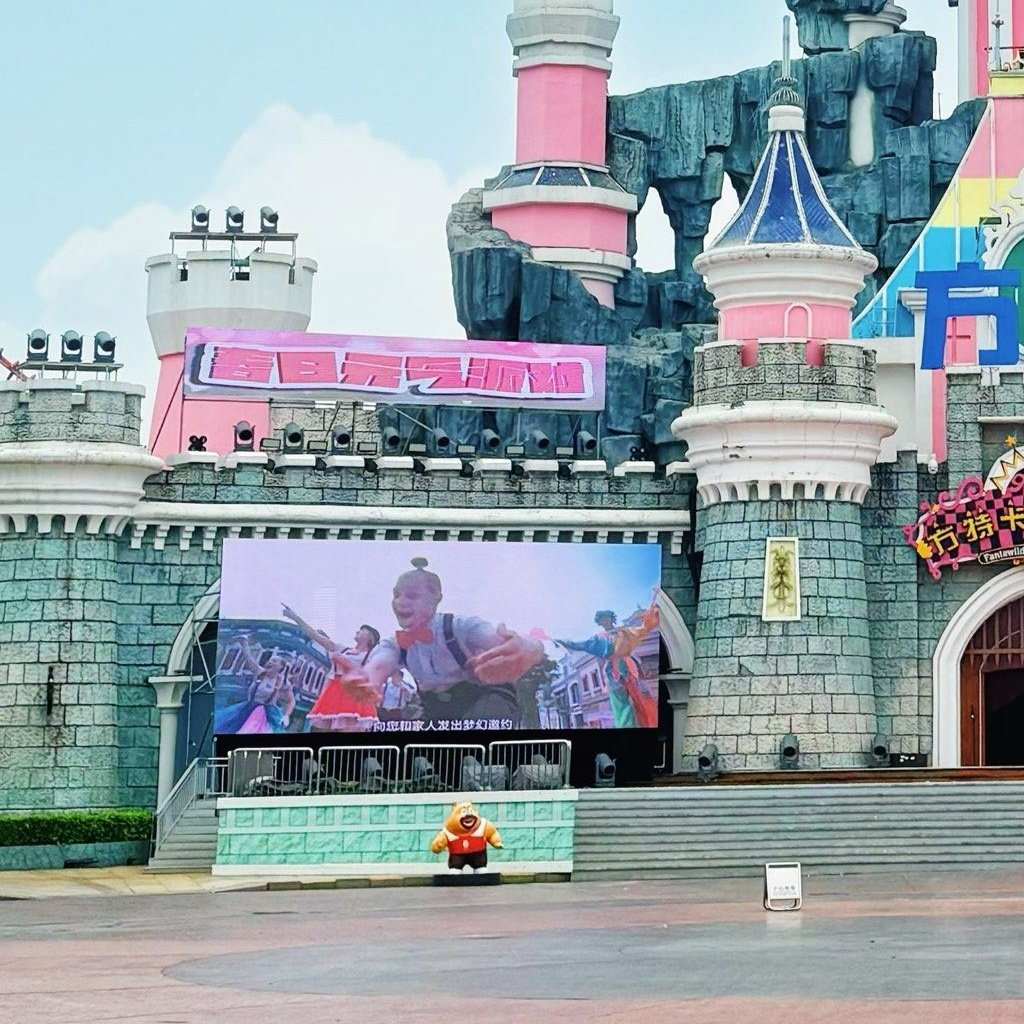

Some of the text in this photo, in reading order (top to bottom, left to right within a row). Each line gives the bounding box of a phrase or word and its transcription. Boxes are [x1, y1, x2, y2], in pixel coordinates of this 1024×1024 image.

[373, 719, 512, 732] 向您和家人发出梦幻邀约
